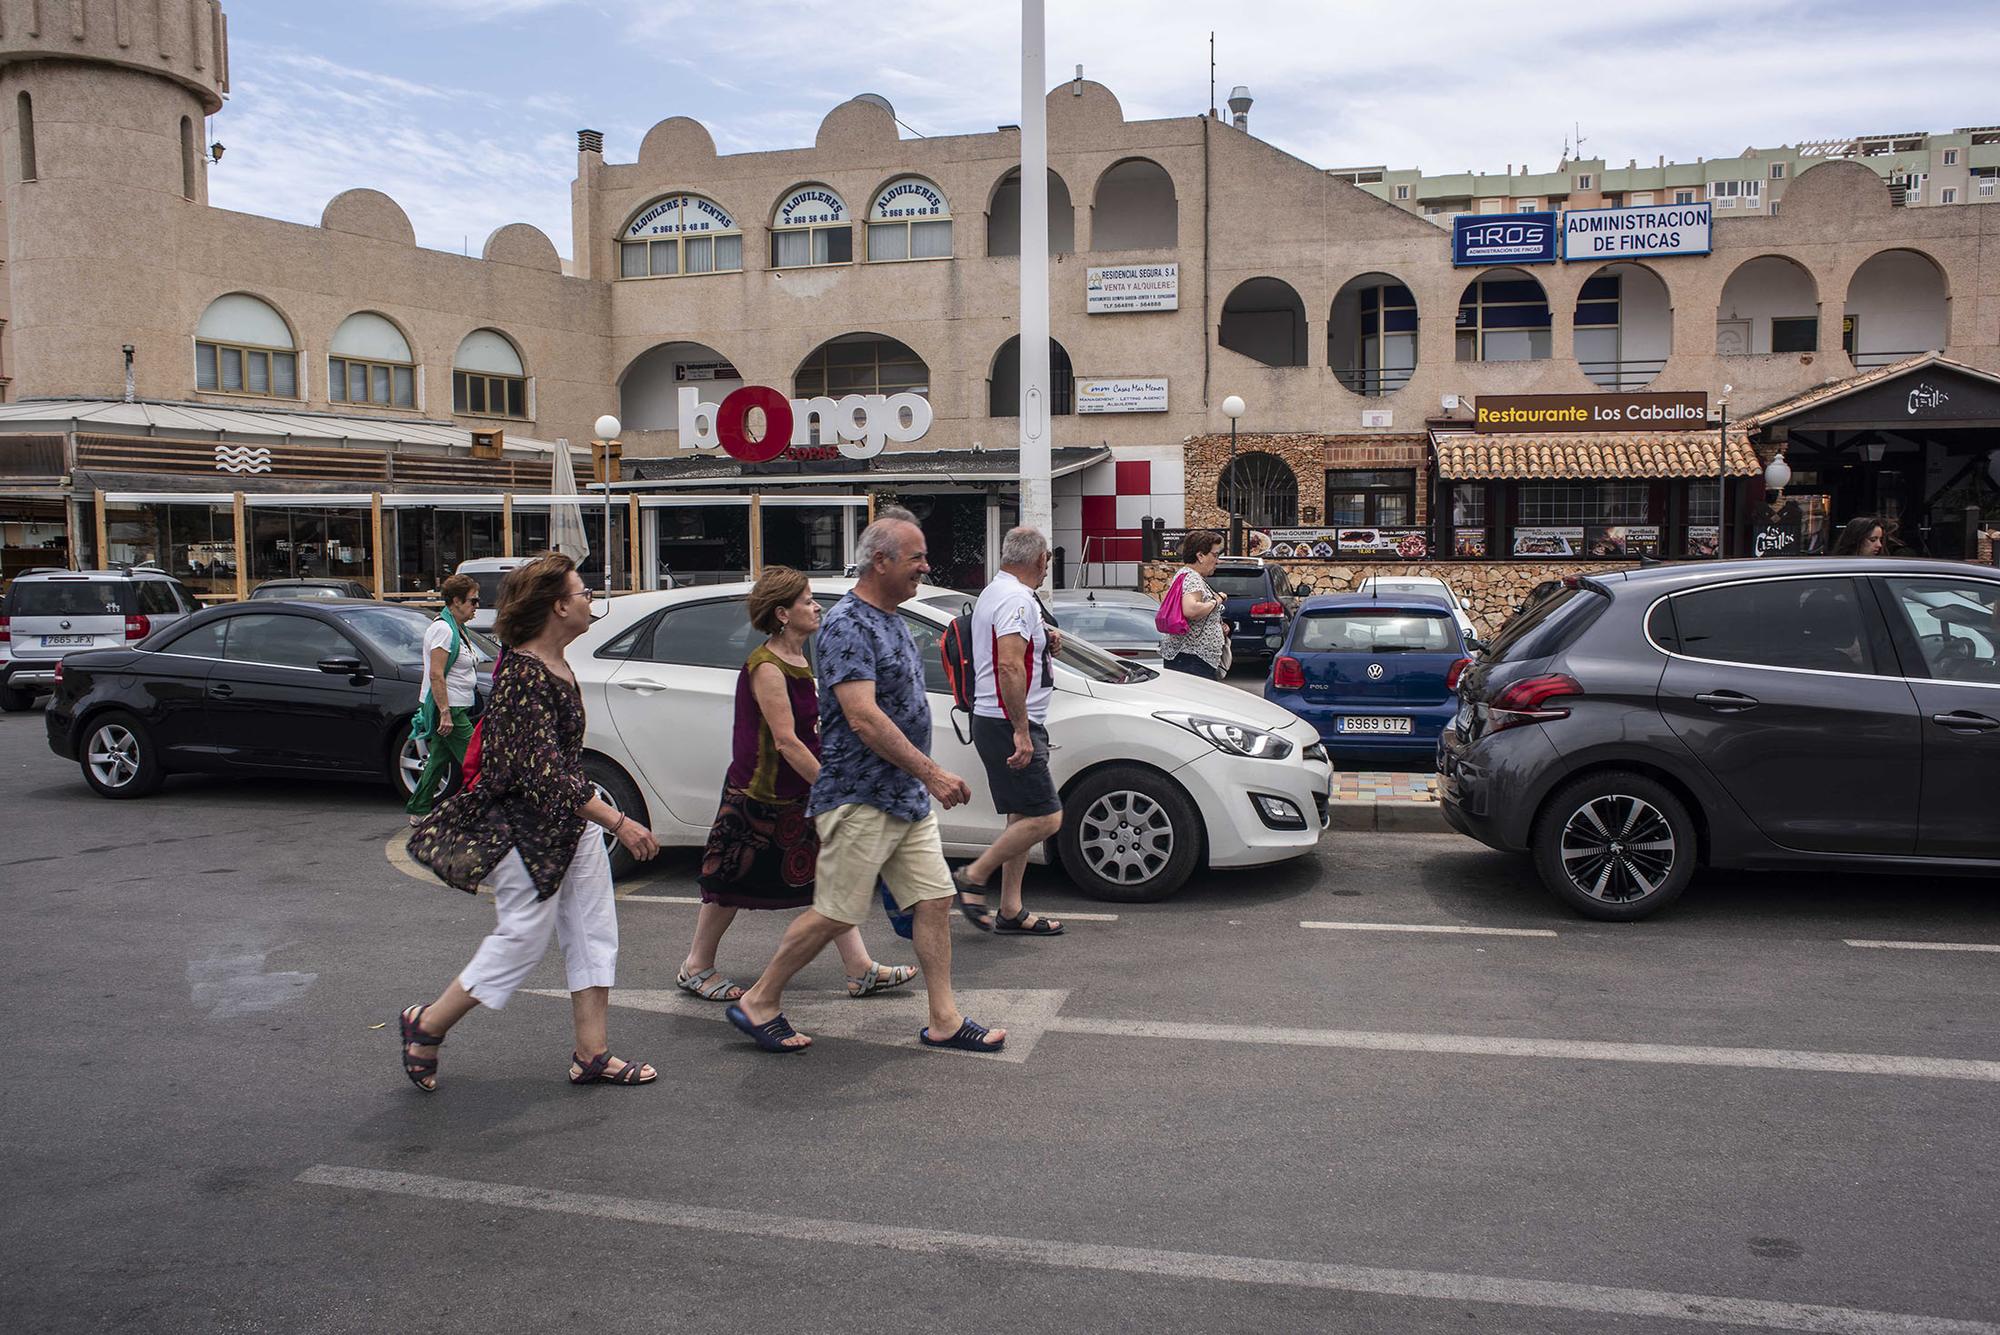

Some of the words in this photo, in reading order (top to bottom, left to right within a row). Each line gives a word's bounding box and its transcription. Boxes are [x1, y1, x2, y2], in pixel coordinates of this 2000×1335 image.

[878, 184, 941, 210] ALQUILERES
[782, 191, 843, 216] ALQUILERES
[631, 198, 688, 235] ALQUILERES
[698, 200, 732, 228] VENTAS
[889, 209, 902, 217] 968
[906, 208, 914, 216] 56
[794, 216, 806, 224] 968
[820, 214, 828, 222] 48
[1568, 210, 1707, 233] ADMINISTRACION
[660, 225, 672, 233] 968
[689, 223, 697, 231] 48
[1594, 237, 1615, 251] DE
[1620, 232, 1680, 250] FINCAS
[1102, 270, 1138, 279] RESIDENCIAL
[1104, 283, 1125, 291] VENTA
[1113, 384, 1130, 393] Casas
[1132, 384, 1144, 392] Mar
[1145, 384, 1164, 392] Menor
[1478, 406, 1588, 423] Restaurante
[1594, 405, 1621, 421] Los
[1626, 404, 1704, 421] Caballos
[784, 447, 837, 461] COPAS
[48, 636, 71, 644] 7665
[1347, 718, 1378, 729] 6969
[1383, 718, 1407, 730] GTZ
